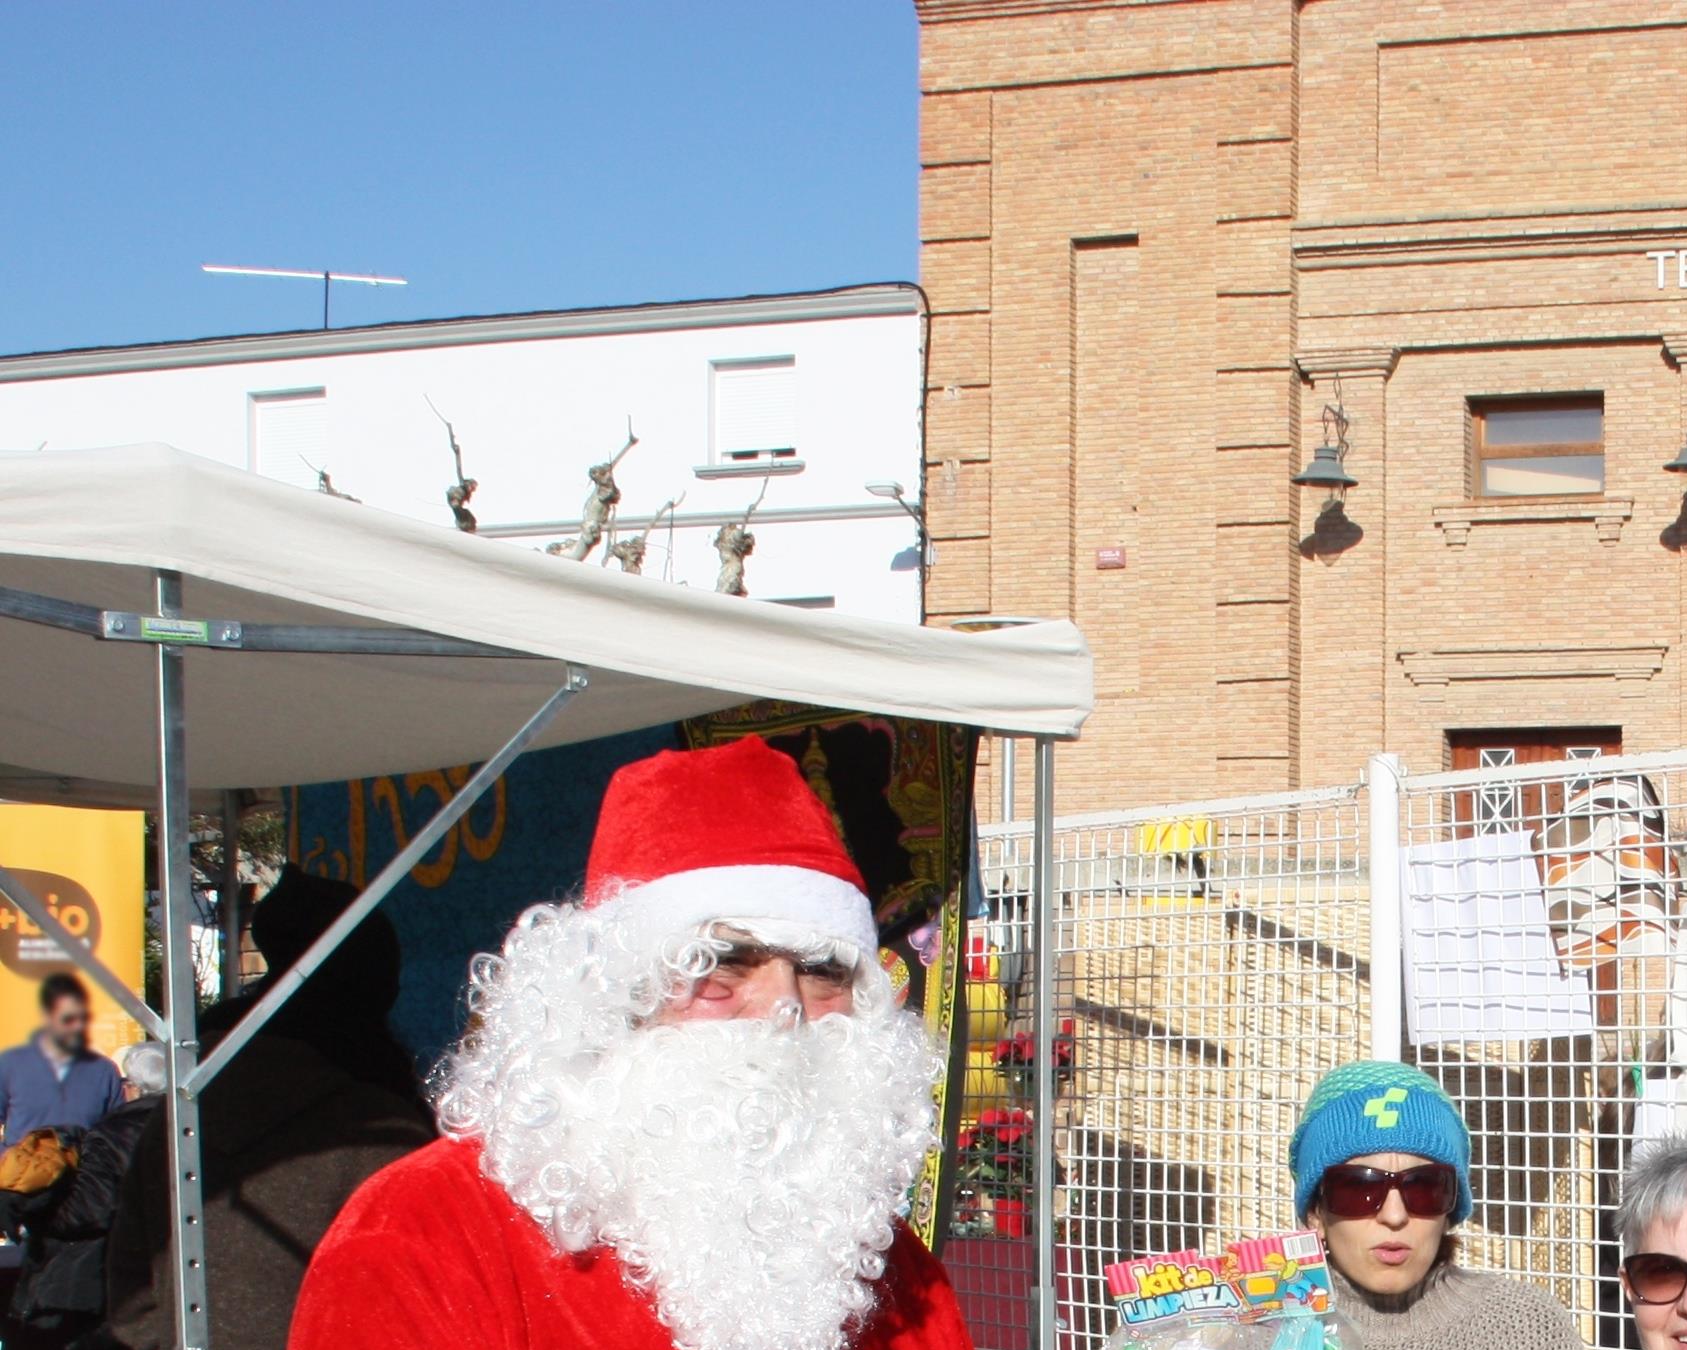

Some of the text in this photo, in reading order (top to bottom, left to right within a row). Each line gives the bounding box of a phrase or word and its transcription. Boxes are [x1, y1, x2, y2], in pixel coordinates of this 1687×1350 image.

[1132, 1263, 1214, 1299] kit de
[1122, 1284, 1240, 1324] LIMPIEZA
